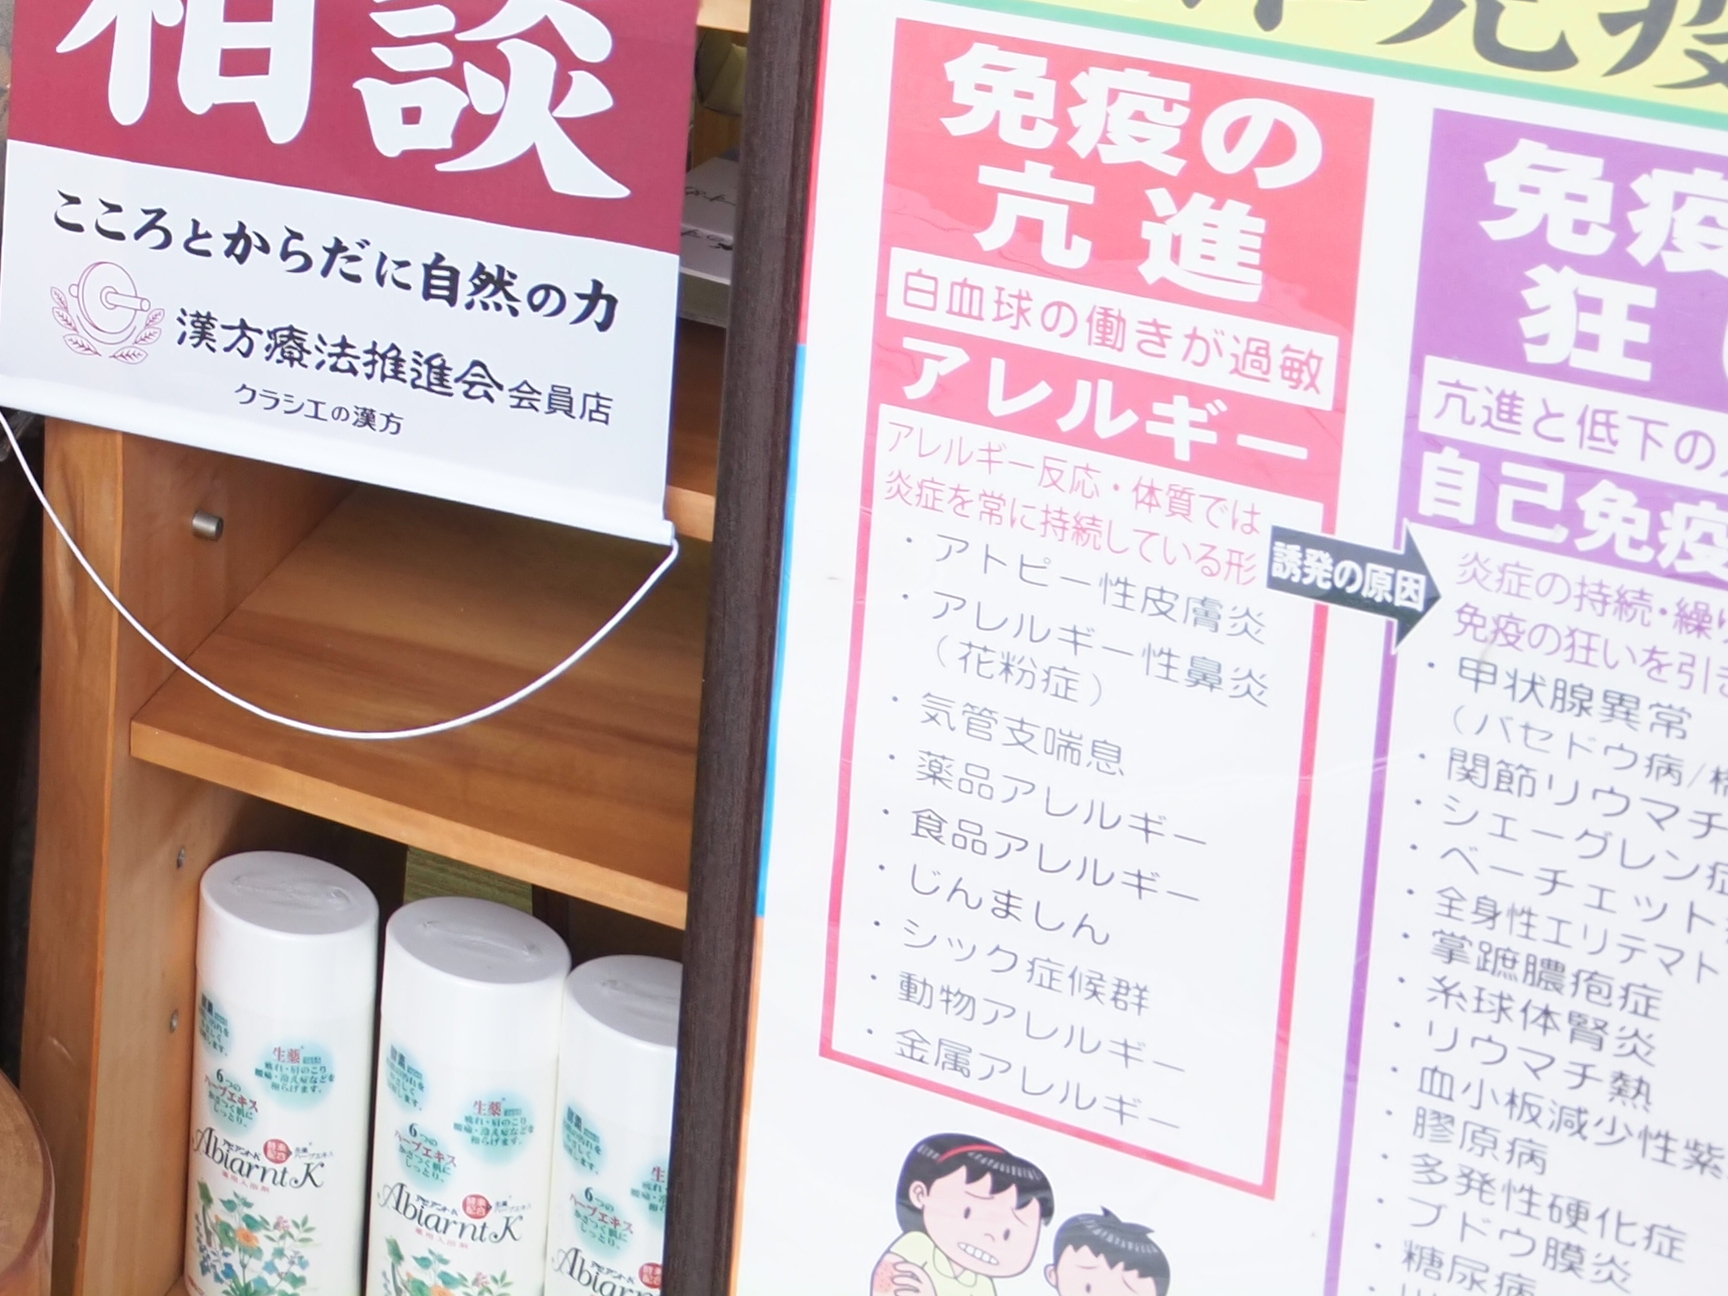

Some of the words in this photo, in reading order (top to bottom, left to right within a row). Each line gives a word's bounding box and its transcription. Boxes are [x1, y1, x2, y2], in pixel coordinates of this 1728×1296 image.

[939, 40, 1325, 190] 免疫の
[52, 188, 622, 335] こころとからだに自然の力
[972, 158, 1267, 303] 亢進
[901, 265, 1326, 397] 白血球の働きが過敏
[232, 381, 405, 437] クラシエの漢方
[898, 334, 1310, 464] アレルギー
[886, 419, 1262, 534] アレルギー反応・体質では
[883, 468, 1258, 588] 炎症を常に持続している形
[1270, 538, 1427, 614] 誘発の原因
[935, 530, 1268, 647] アトピー性皮膚炎
[931, 588, 1270, 708] アレルギー性鼻炎
[1457, 655, 1694, 742] 甲状腺異常
[919, 690, 1127, 779] 気管支喘息
[915, 747, 1208, 848] 薬品アレルギー
[907, 861, 1112, 948] じんましん
[910, 805, 1202, 905] 食品アレルギー
[902, 916, 1152, 1016] シック症候群
[1430, 928, 1665, 1023] 掌蹠膿疱症
[897, 969, 1187, 1074] 動物アレルギー
[1425, 974, 1660, 1068] 糸球体腎炎
[1427, 1019, 1655, 1115] リウマチ熱
[893, 1027, 1182, 1130] 金属アレルギー
[1411, 1105, 1550, 1178] 膠原病
[1407, 1194, 1634, 1296] ブドウ膜炎
[1409, 1152, 1688, 1266] 多発性硬化症
